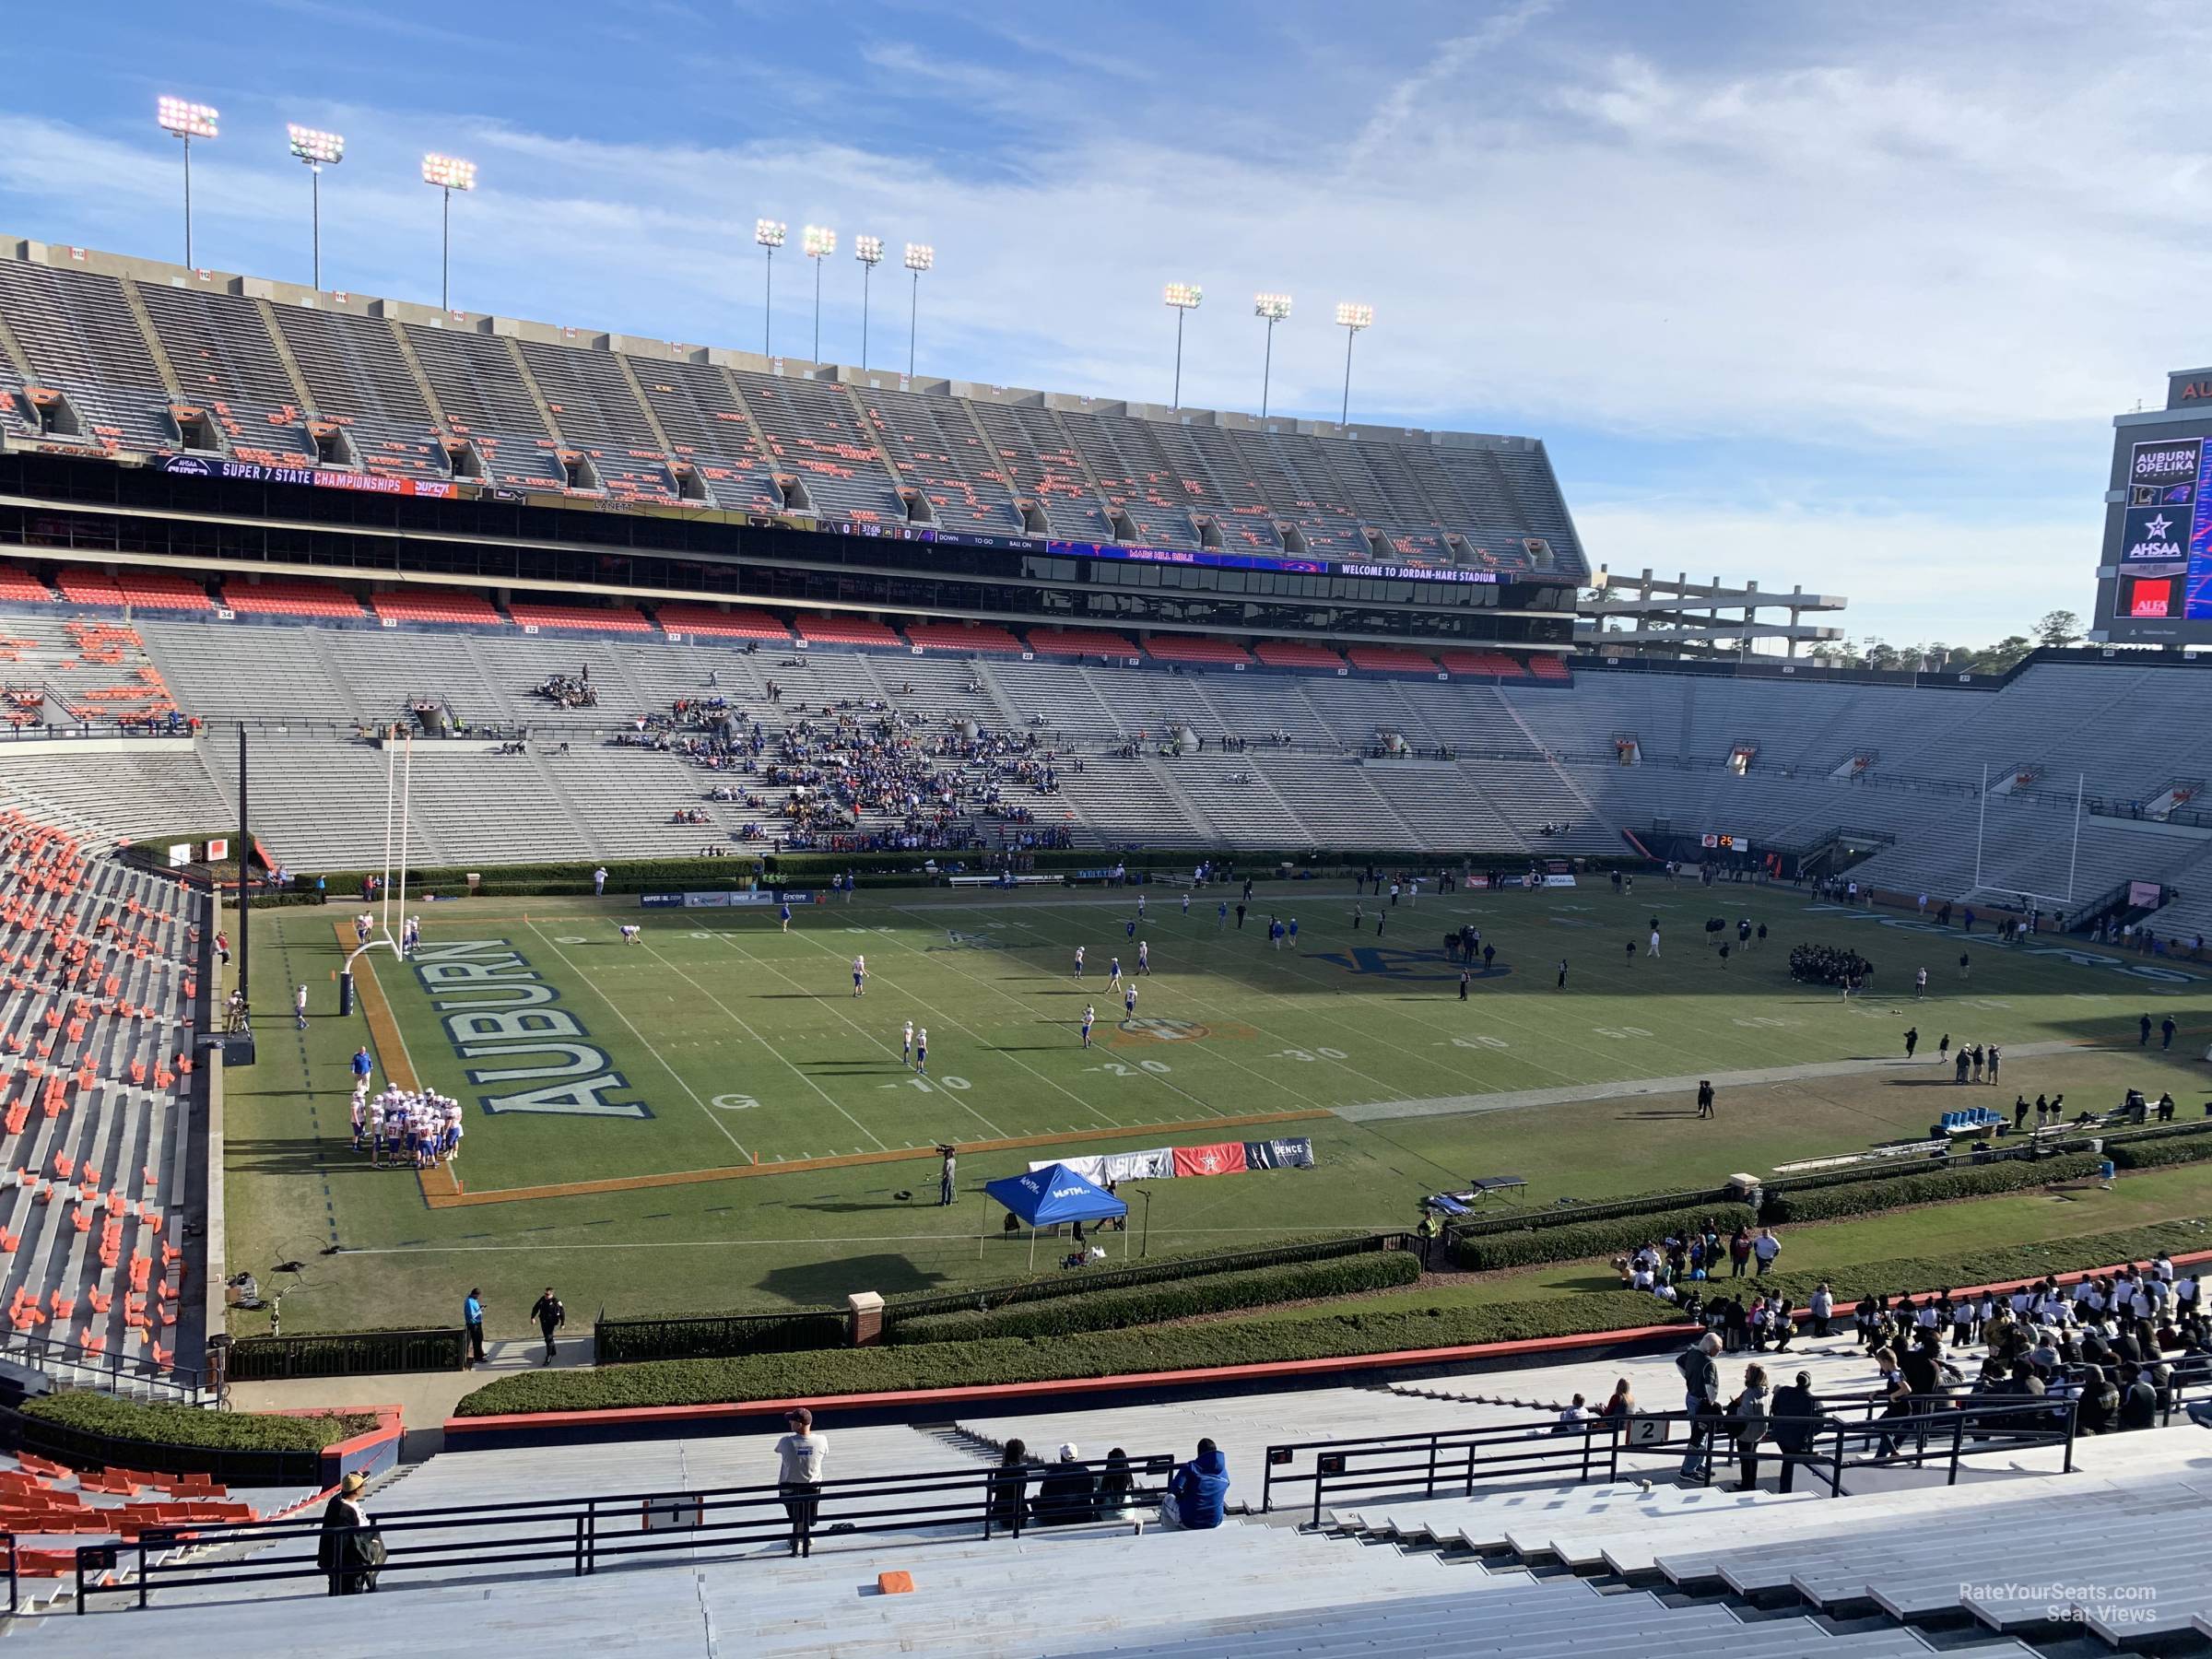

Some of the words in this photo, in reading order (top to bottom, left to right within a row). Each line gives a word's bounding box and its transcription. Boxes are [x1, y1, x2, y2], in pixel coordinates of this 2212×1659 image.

[2137, 450, 2195, 464] AUBURN
[2136, 461, 2194, 474] OPELIKA
[222, 463, 260, 479] SUPER
[265, 467, 272, 479] 7
[276, 468, 311, 484] STATE
[313, 472, 401, 492] CHAMPIONSHIPS
[594, 500, 633, 512] LANETT
[842, 524, 850, 534] 0
[862, 524, 881, 534] 37:06
[904, 529, 912, 539] 0
[2130, 542, 2181, 556] AHSAA
[1153, 552, 1171, 560] HILL
[1172, 553, 1194, 562] BIBLE
[1342, 564, 1382, 576] WELCOME
[1384, 567, 1396, 577] TO
[1398, 568, 1456, 581] JORDAN-HARE
[1459, 571, 1497, 583] STADIUM
[2136, 600, 2168, 610] ALFA
[1720, 836, 1733, 846] 25
[406, 938, 655, 1119] AUBURN
[1593, 1026, 1654, 1039] 50
[1451, 1036, 1509, 1049] 40
[1282, 1047, 1348, 1061] 30
[1103, 1060, 1171, 1077] 20
[906, 1076, 971, 1092] 10
[712, 1094, 760, 1110] G
[1641, 1422, 1654, 1439] 2
